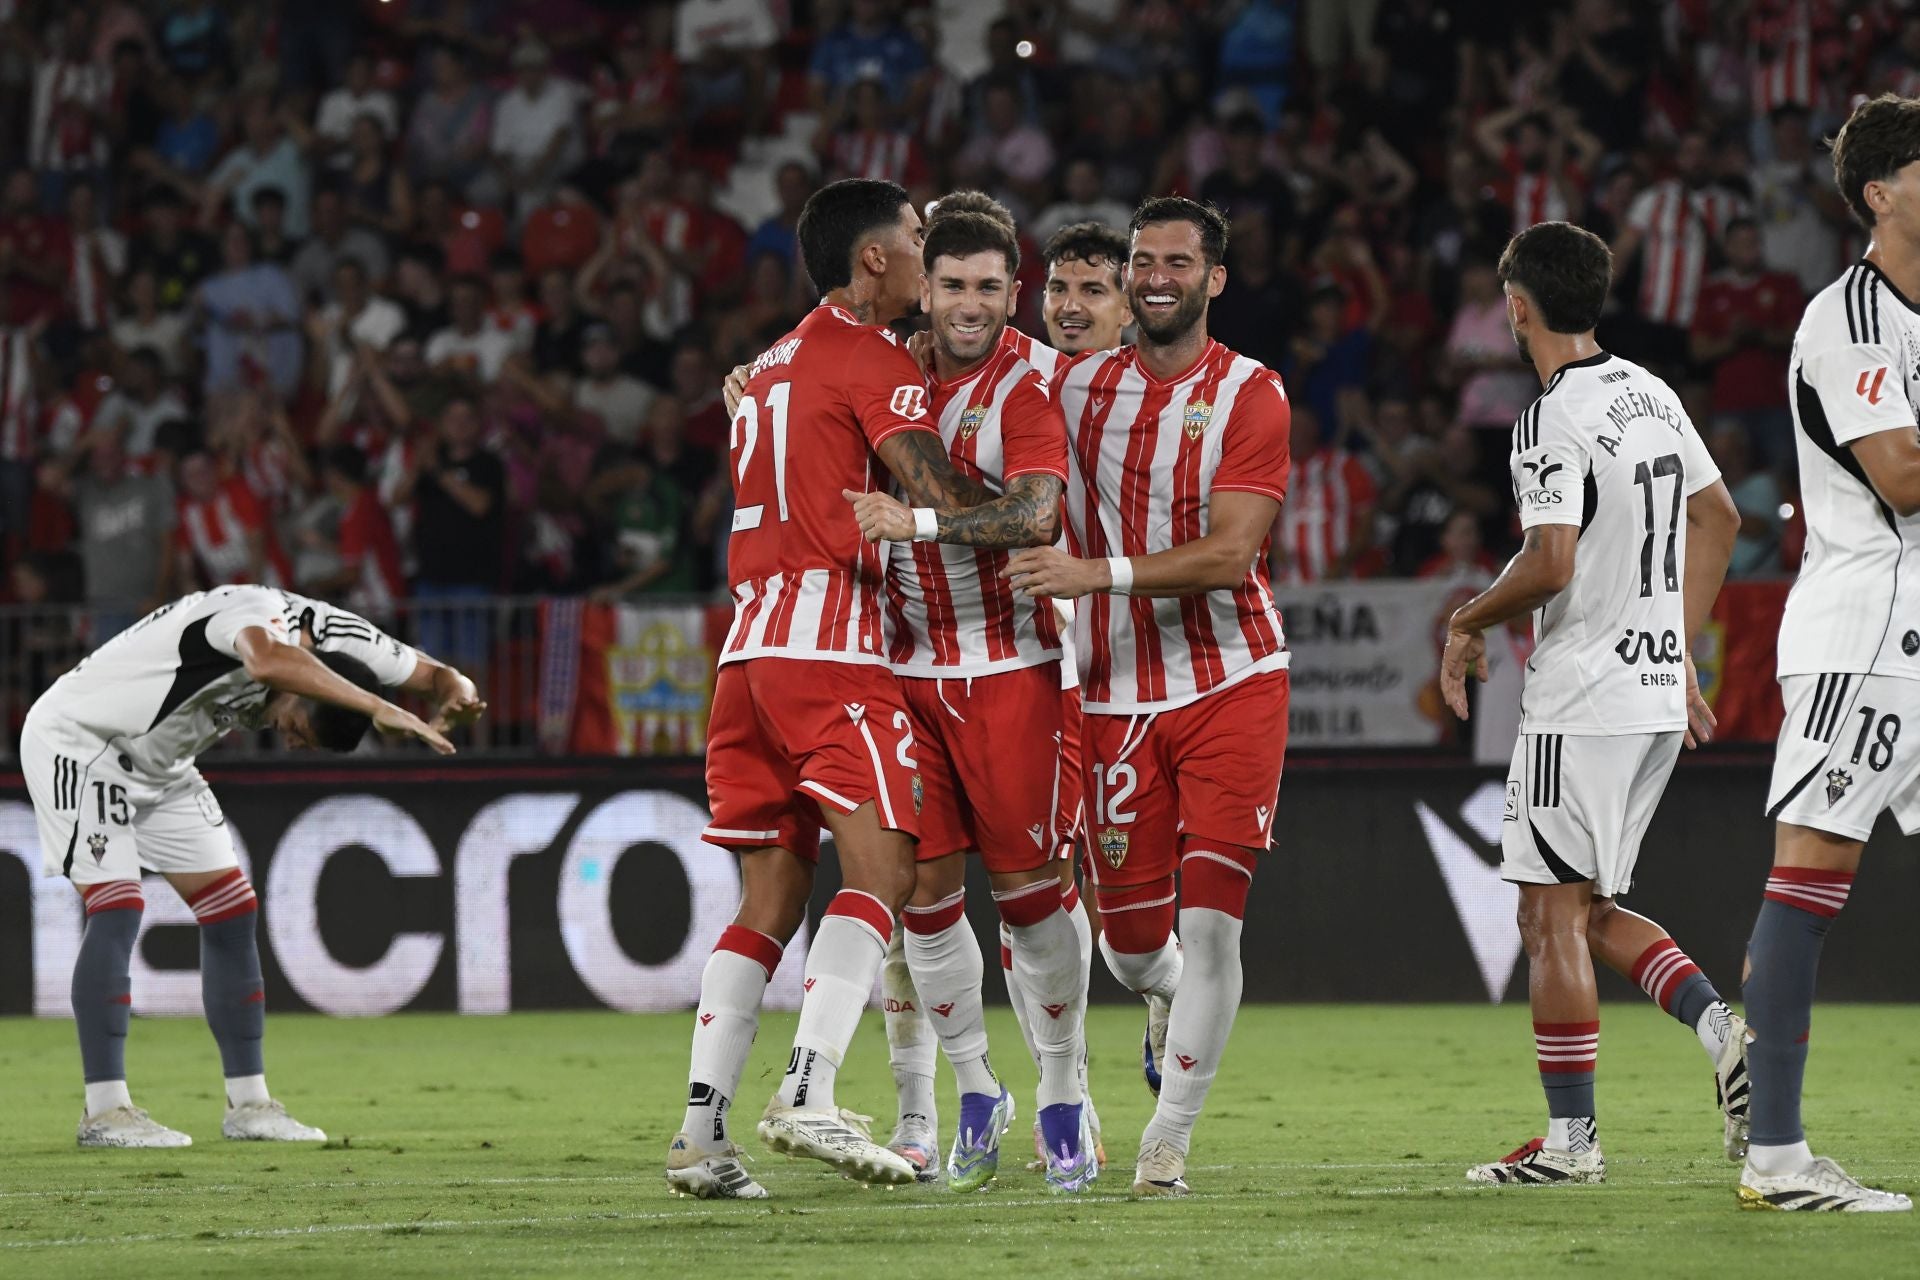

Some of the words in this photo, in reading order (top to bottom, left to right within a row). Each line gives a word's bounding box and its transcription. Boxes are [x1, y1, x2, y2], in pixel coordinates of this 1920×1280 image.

[1607, 387, 1684, 437] MELÉNDEZ
[730, 381, 791, 533] 21
[1597, 434, 1622, 457] A.
[1528, 490, 1563, 505] MGS
[1633, 453, 1684, 598] 17
[893, 710, 918, 769] 2
[1850, 706, 1901, 772] 18
[92, 781, 129, 826] 15
[1092, 762, 1137, 825] 12
[884, 1000, 916, 1012] UDA
[716, 1097, 728, 1117] TAP
